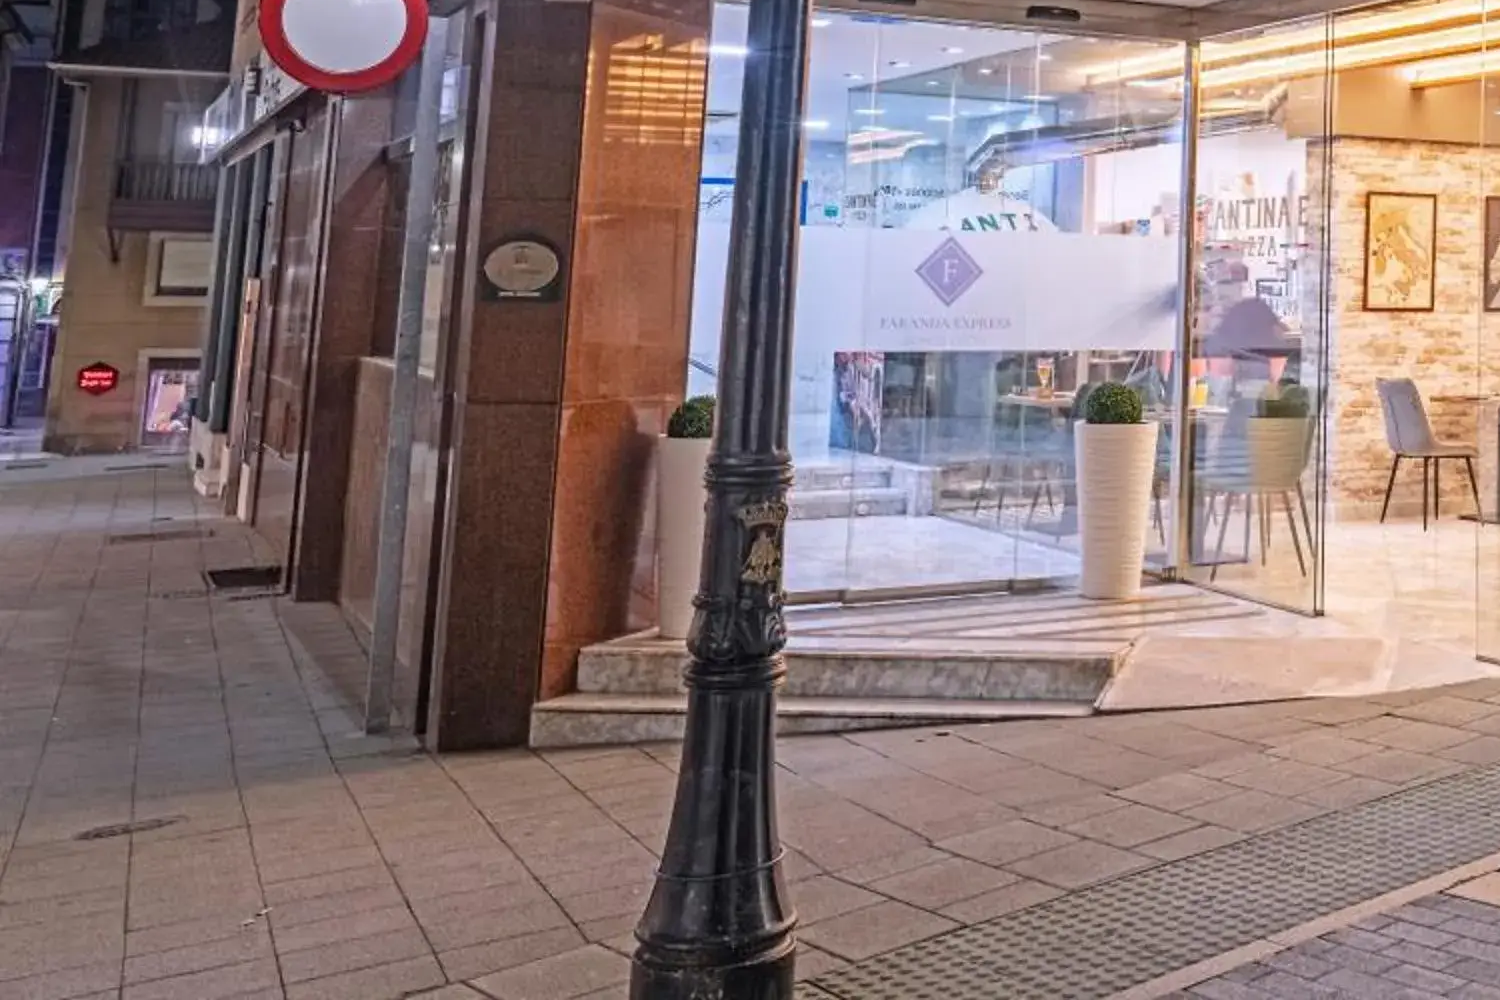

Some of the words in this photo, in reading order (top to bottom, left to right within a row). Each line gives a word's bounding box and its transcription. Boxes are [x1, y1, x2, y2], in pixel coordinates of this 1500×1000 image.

[942, 258, 959, 283] F
[879, 316, 951, 330] FARANDA
[953, 316, 1012, 330] EXPRESS
